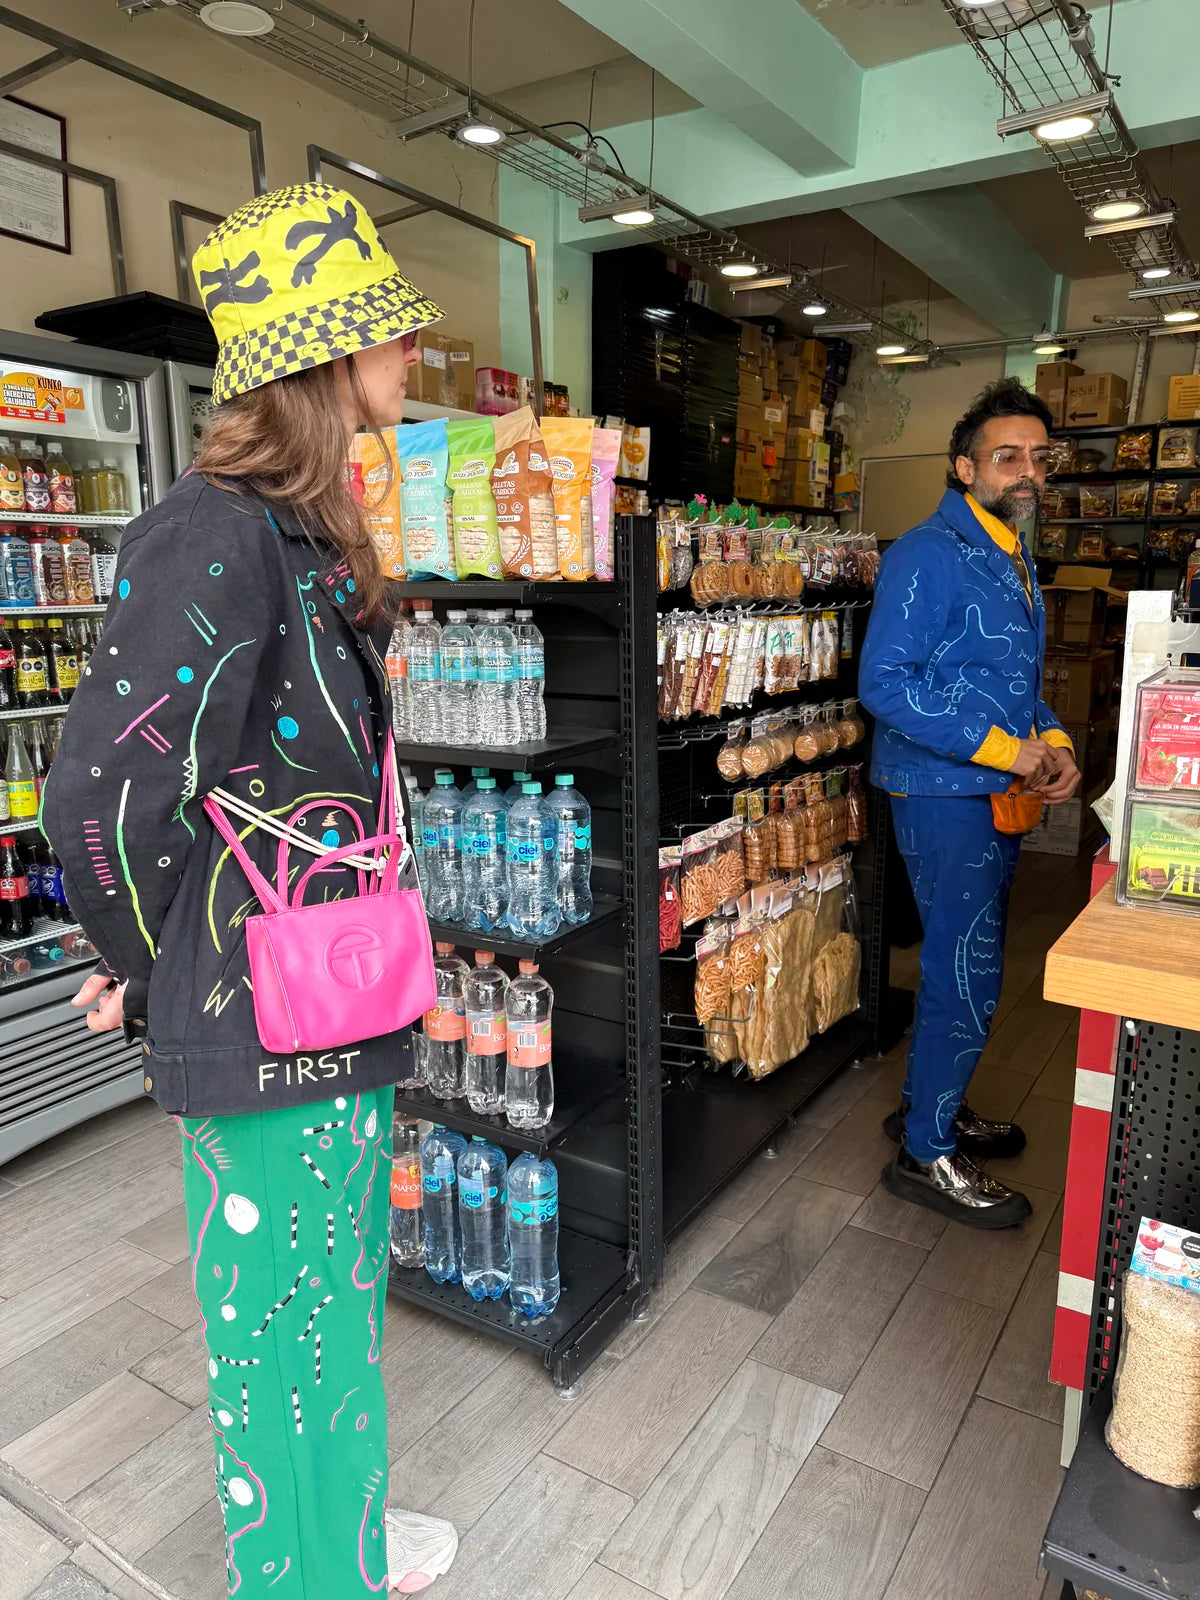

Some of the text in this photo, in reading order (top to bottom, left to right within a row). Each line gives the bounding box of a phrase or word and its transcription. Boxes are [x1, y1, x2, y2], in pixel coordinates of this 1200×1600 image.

[37, 376, 62, 391] KUNKO
[5, 397, 37, 408] SALUDABLE
[472, 837, 492, 849] ciel
[518, 844, 538, 856] ciel
[258, 1050, 361, 1092] FIRST
[424, 1177, 440, 1188] ciel
[465, 1193, 482, 1203] ciel
